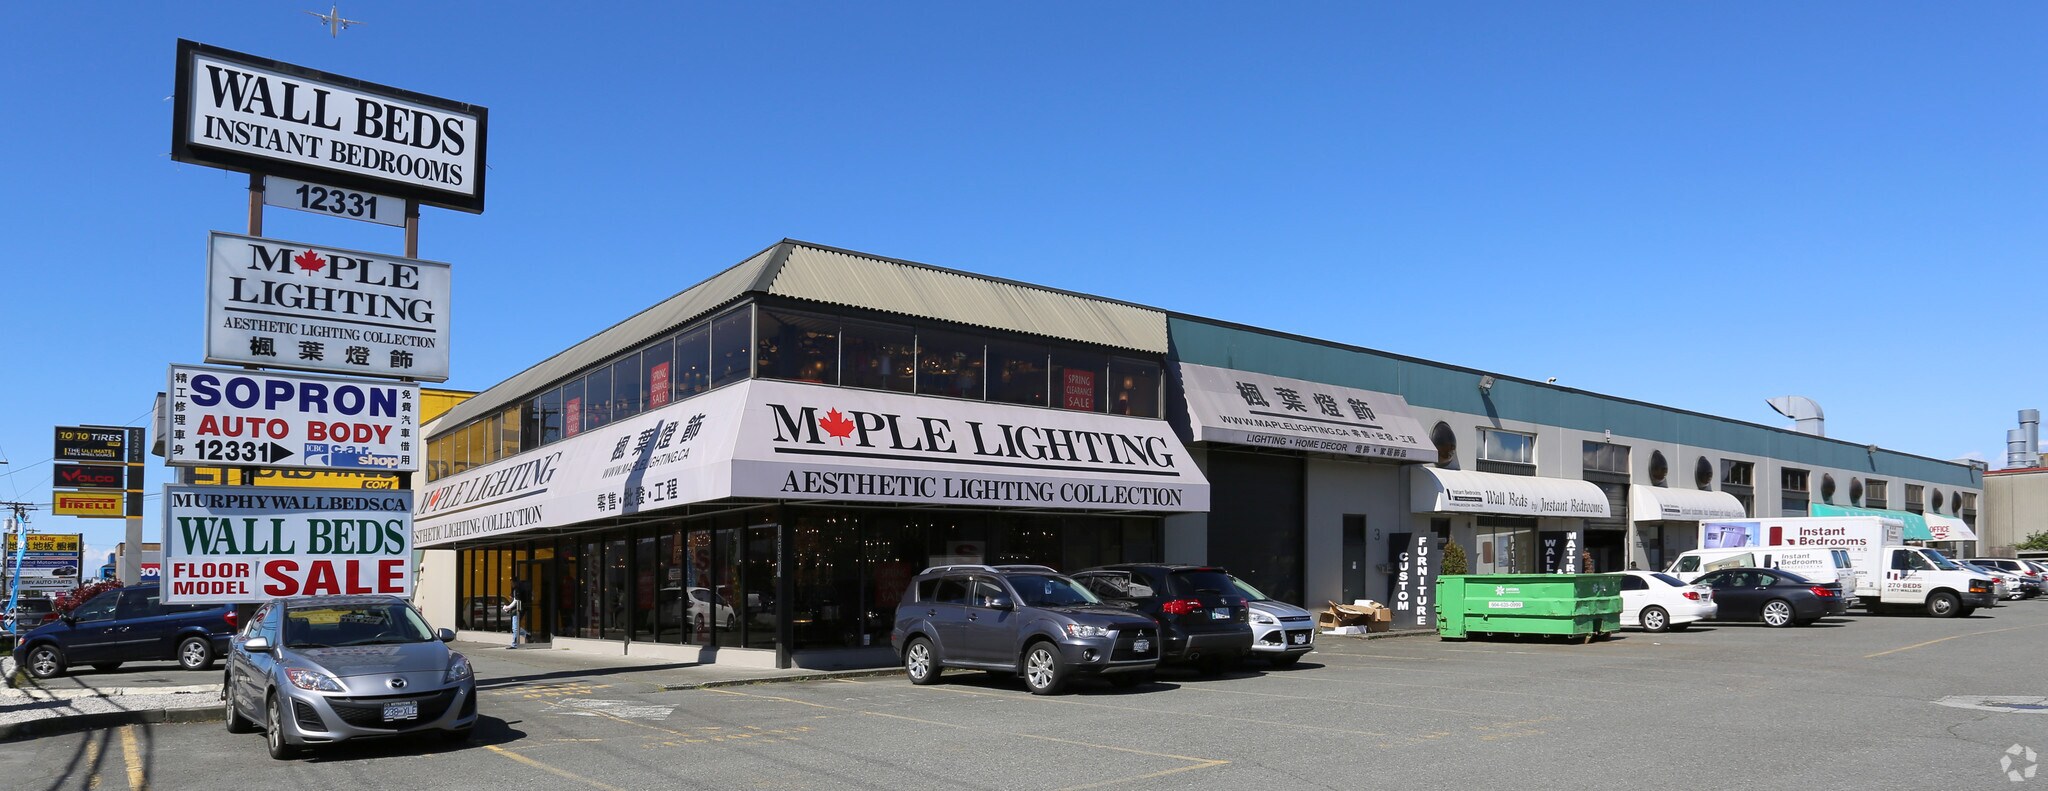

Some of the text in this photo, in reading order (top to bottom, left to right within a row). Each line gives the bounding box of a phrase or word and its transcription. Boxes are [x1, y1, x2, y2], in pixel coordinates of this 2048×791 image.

[206, 65, 464, 156] WALL BEDS
[204, 115, 462, 186] INSTANT BEDROOMS
[296, 184, 377, 219] 12331
[229, 276, 435, 324] LIGHTING
[224, 316, 435, 348] AESTHETIC LIGHTING COLLECTION
[652, 368, 666, 381] SPRING
[1068, 374, 1090, 386] SPRING
[190, 374, 397, 418] SOPRON
[652, 392, 665, 405] SALE
[1066, 385, 1092, 396] CLEARANCE
[1069, 396, 1090, 408] SALE
[173, 372, 187, 455] 精工修理車身
[400, 389, 412, 465] 免費汽車借用
[1219, 415, 1350, 437] WWW.MAPLELIGHTING.CA
[197, 414, 392, 444] AUTO BODY
[1246, 434, 1347, 452] LIGHTING HOME DECOR
[195, 439, 268, 462] 12331
[306, 444, 324, 452] ICBC
[358, 451, 399, 468] shop
[965, 421, 1175, 468] LIGHTING
[464, 451, 563, 504] LIGHTING
[780, 470, 1182, 506] AESTHETIC LIGHTING COLLECTION
[60, 497, 116, 509] PIRELLI
[172, 493, 407, 512] MURPHYWALLBEDS.CA
[1486, 490, 1604, 513] Wall Beds by Instant Bedrooms
[177, 517, 405, 556] WALL BEDS
[444, 518, 480, 539] LIGHTING
[482, 505, 543, 532] COLLECTION
[1800, 527, 1845, 536] Instant
[1929, 526, 1950, 534] OFFICE
[1566, 532, 1576, 574] MATTR
[1800, 537, 1867, 546] Bedrooms
[173, 563, 249, 578] FLOOR
[1545, 540, 1556, 574] WALL
[173, 581, 249, 595] MODEL
[264, 559, 404, 597] SALE
[1397, 552, 1409, 611] CUSTOM
[1416, 537, 1428, 625] FURNITURE
